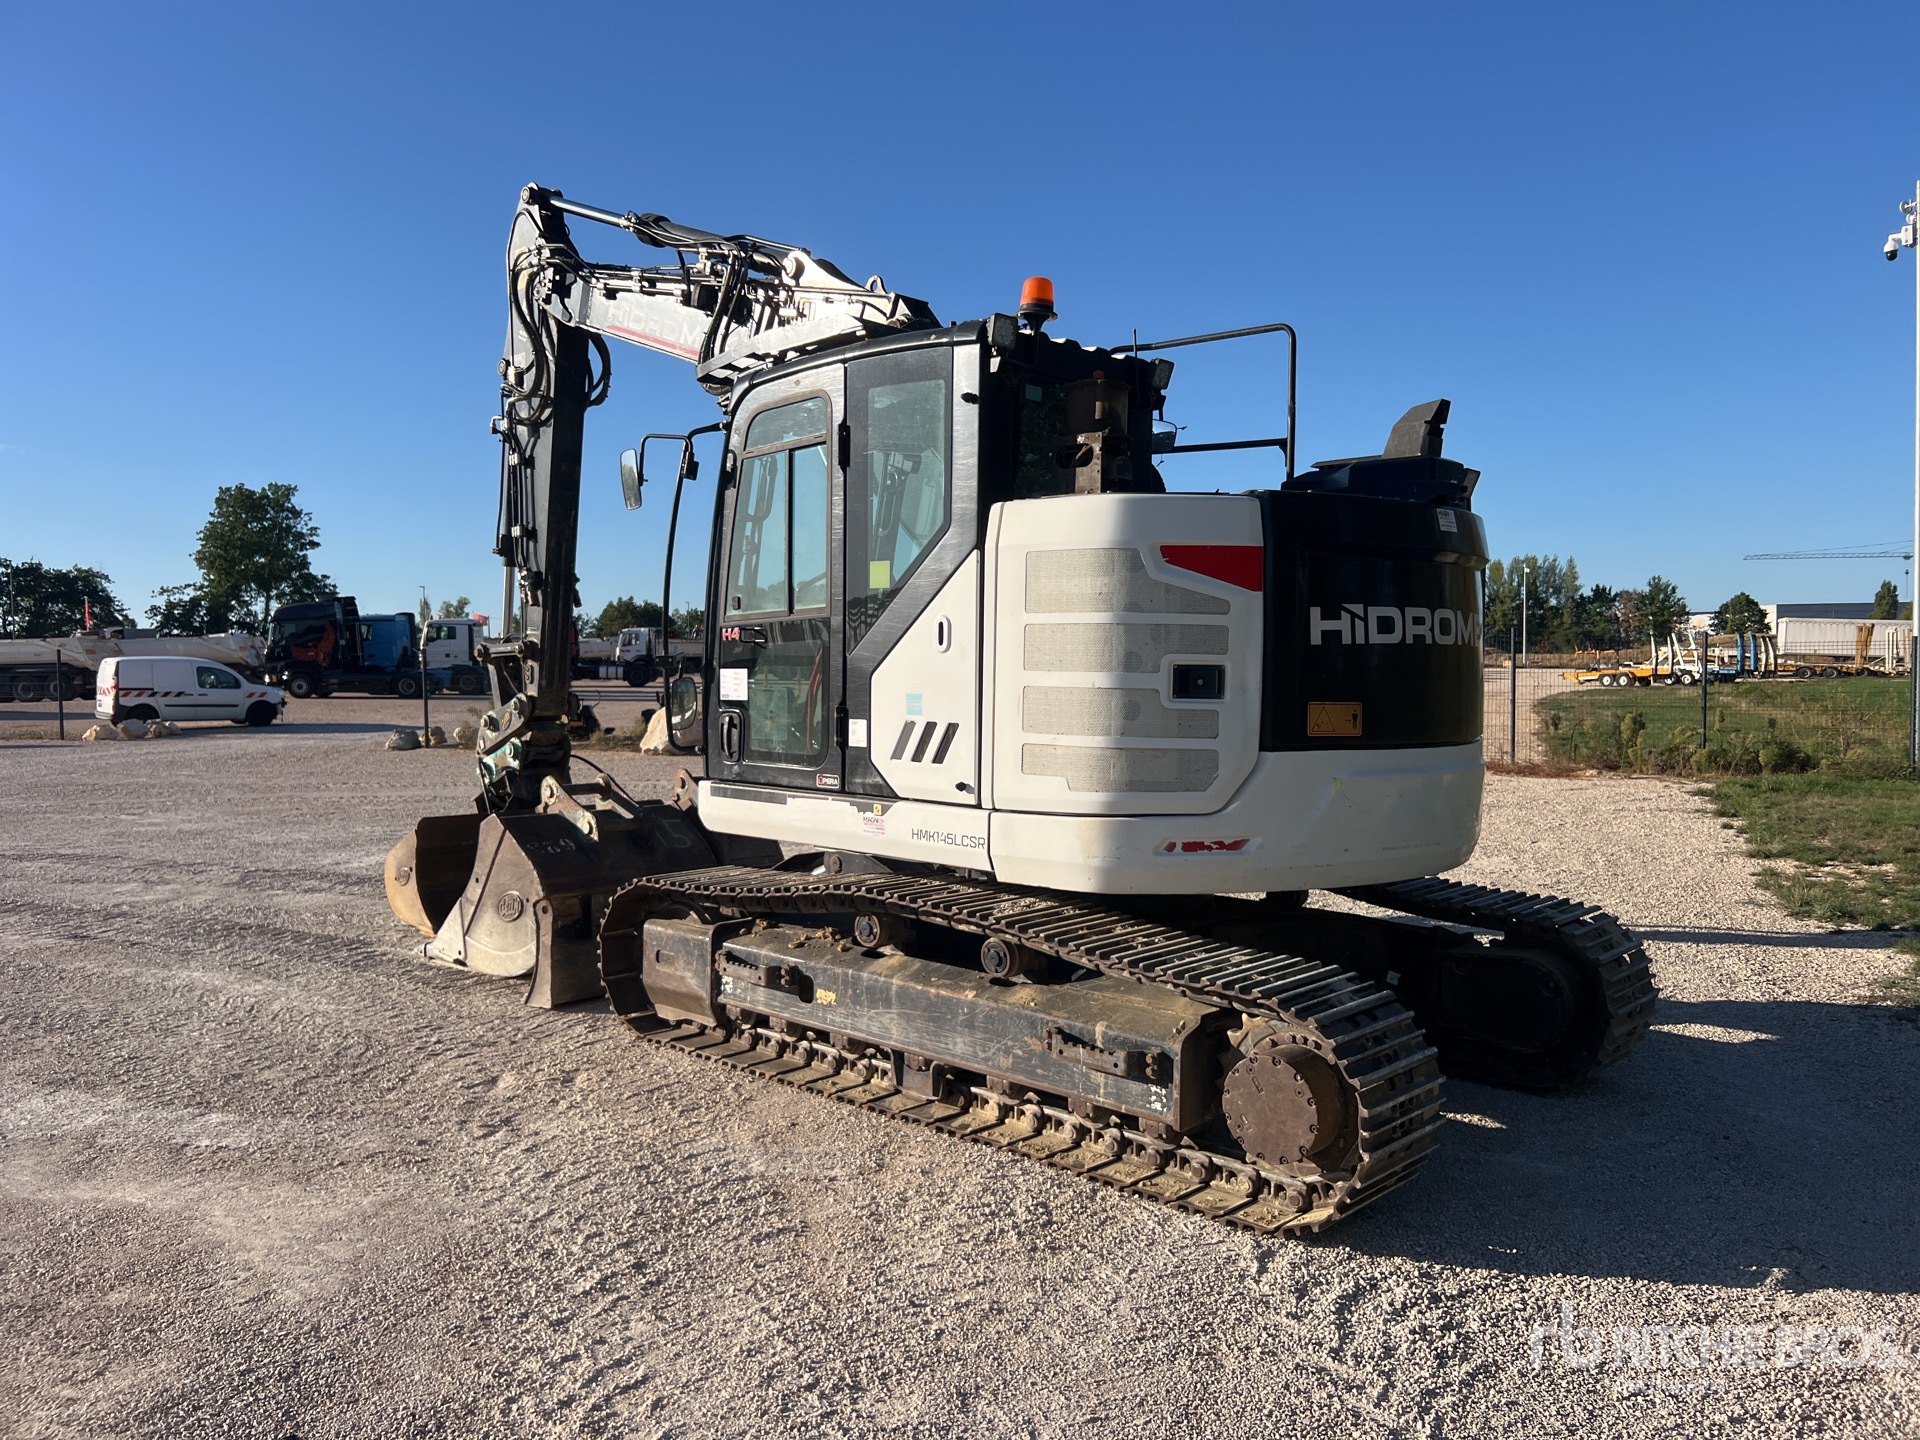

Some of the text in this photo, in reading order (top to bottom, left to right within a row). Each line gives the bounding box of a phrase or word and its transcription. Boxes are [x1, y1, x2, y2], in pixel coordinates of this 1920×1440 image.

[722, 627, 740, 641] H4
[818, 776, 838, 785] OPERA
[911, 828, 986, 850] HMK145LCSR
